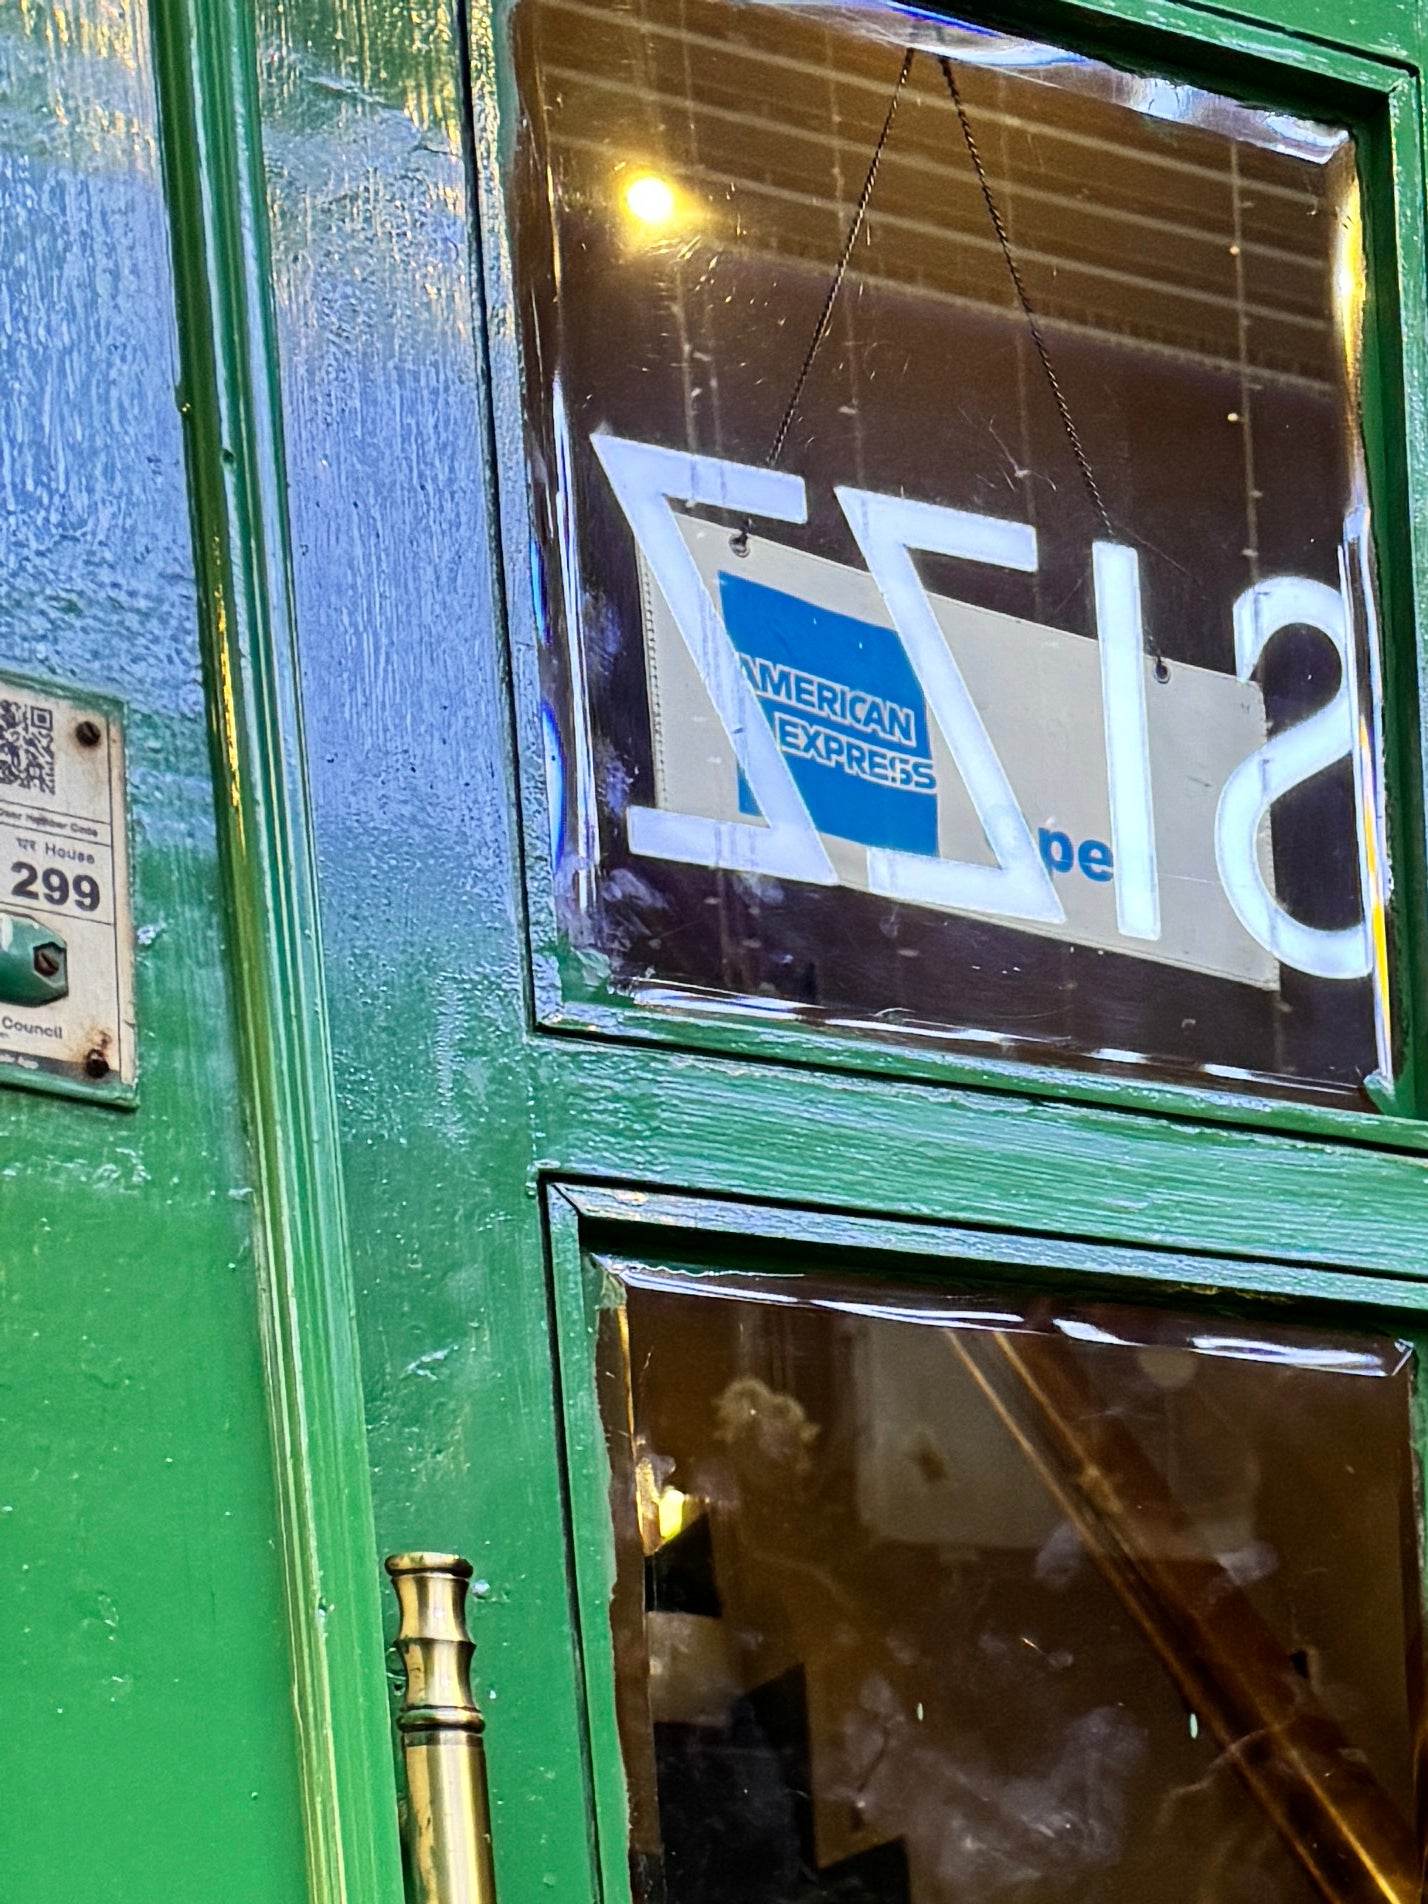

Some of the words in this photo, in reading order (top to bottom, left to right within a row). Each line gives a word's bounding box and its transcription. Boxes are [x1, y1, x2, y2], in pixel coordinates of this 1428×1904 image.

[774, 711, 938, 795] EXPRESS
[45, 842, 96, 864] House
[10, 861, 101, 912] 299
[2, 1015, 63, 1039] Council
